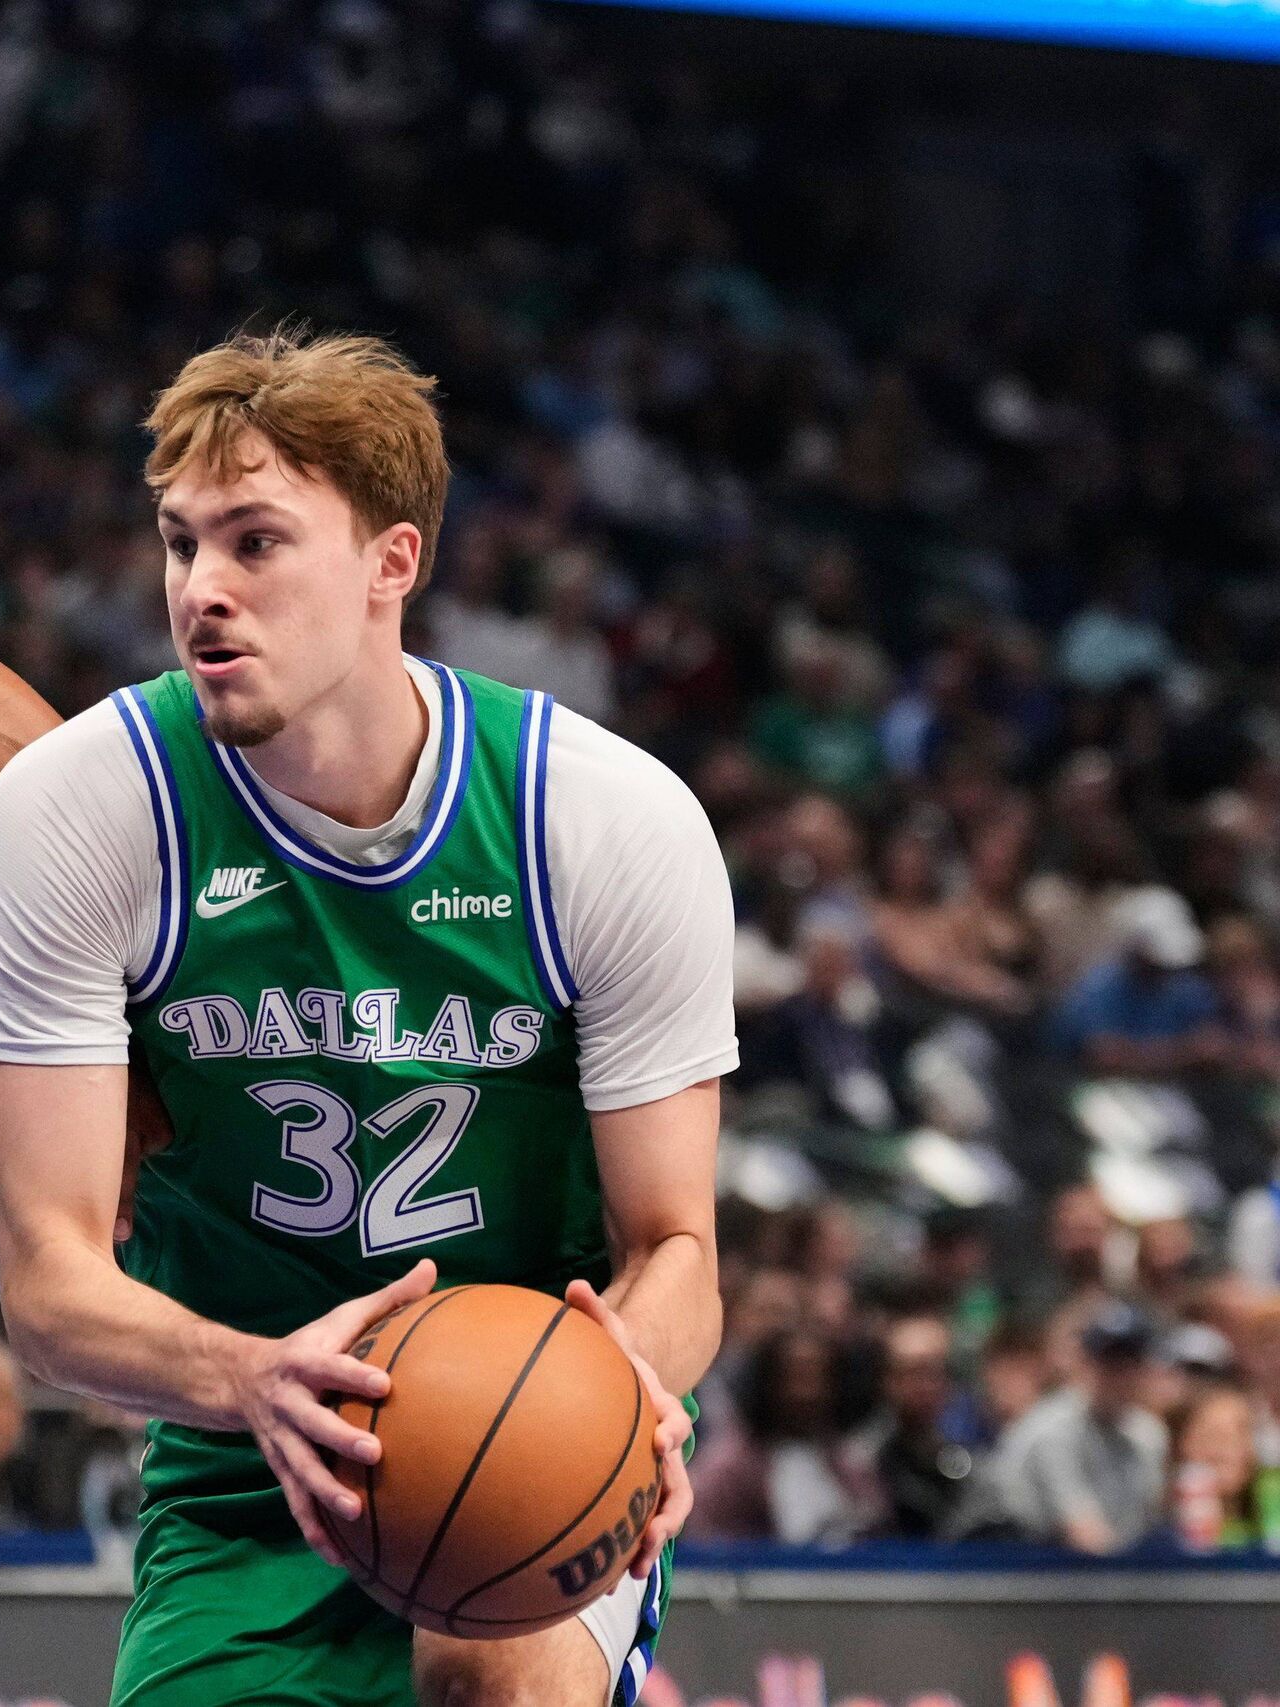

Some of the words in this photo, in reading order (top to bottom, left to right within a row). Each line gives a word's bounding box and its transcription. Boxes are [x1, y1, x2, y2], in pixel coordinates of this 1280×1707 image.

[206, 867, 266, 898] NIKE
[410, 887, 513, 923] chime
[158, 987, 544, 1069] DALLAS
[243, 1079, 485, 1258] 32
